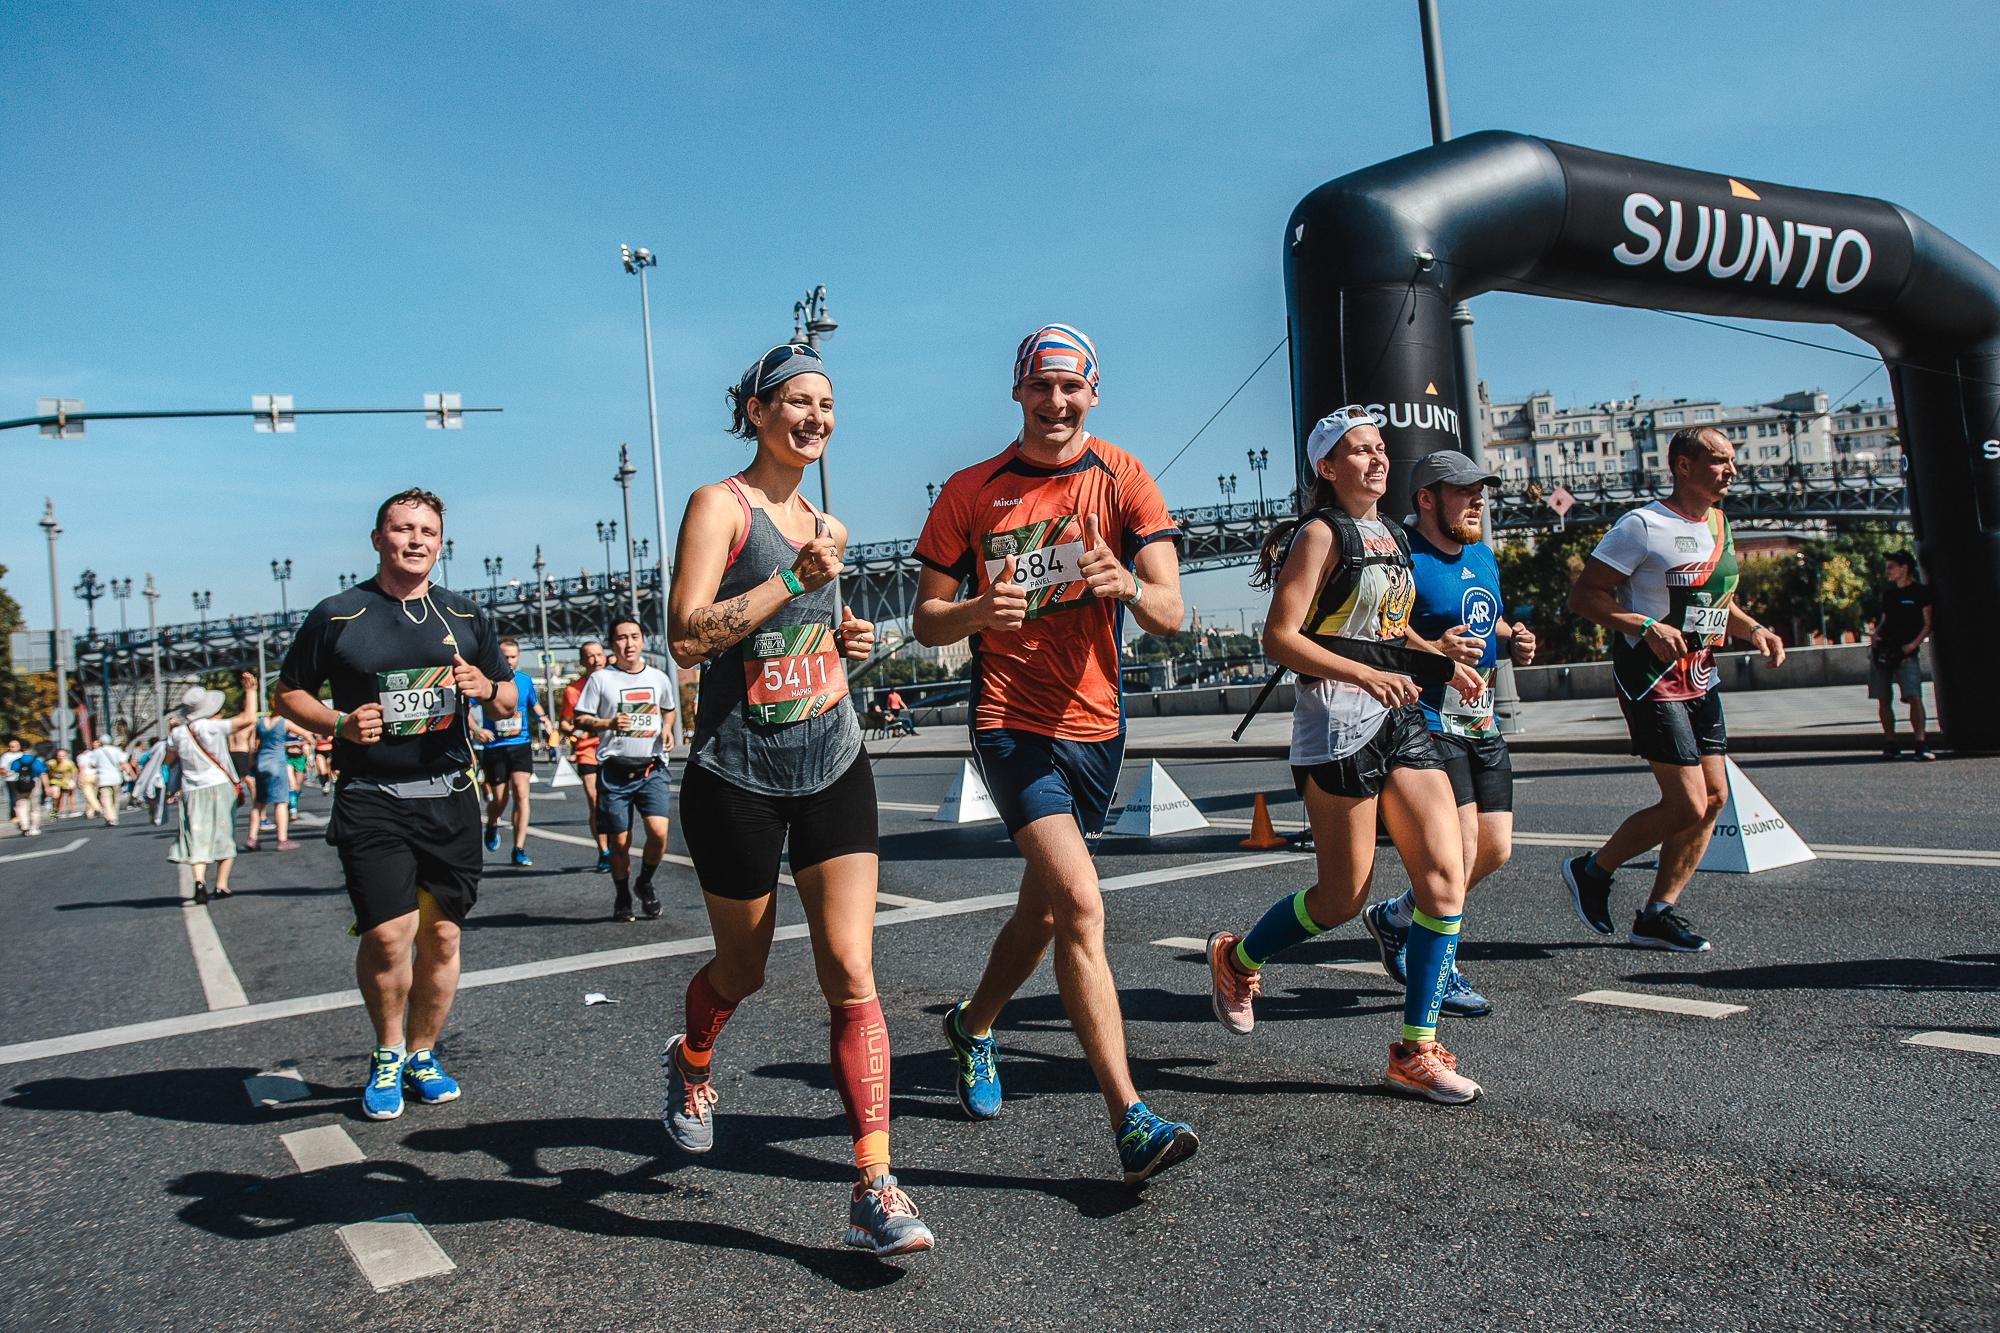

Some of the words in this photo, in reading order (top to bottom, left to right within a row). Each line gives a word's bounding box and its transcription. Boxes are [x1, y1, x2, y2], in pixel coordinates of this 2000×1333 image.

[1613, 192, 1872, 294] SUUNTO
[1364, 402, 1459, 435] SUUNT
[1013, 548, 1064, 583] 684
[1030, 577, 1052, 588] PAVEL
[763, 655, 827, 691] 5411
[393, 689, 445, 712] 3901
[1152, 800, 1190, 813] SUUNTO
[1712, 824, 1738, 837] NTO
[1742, 818, 1785, 836] SUUNTO
